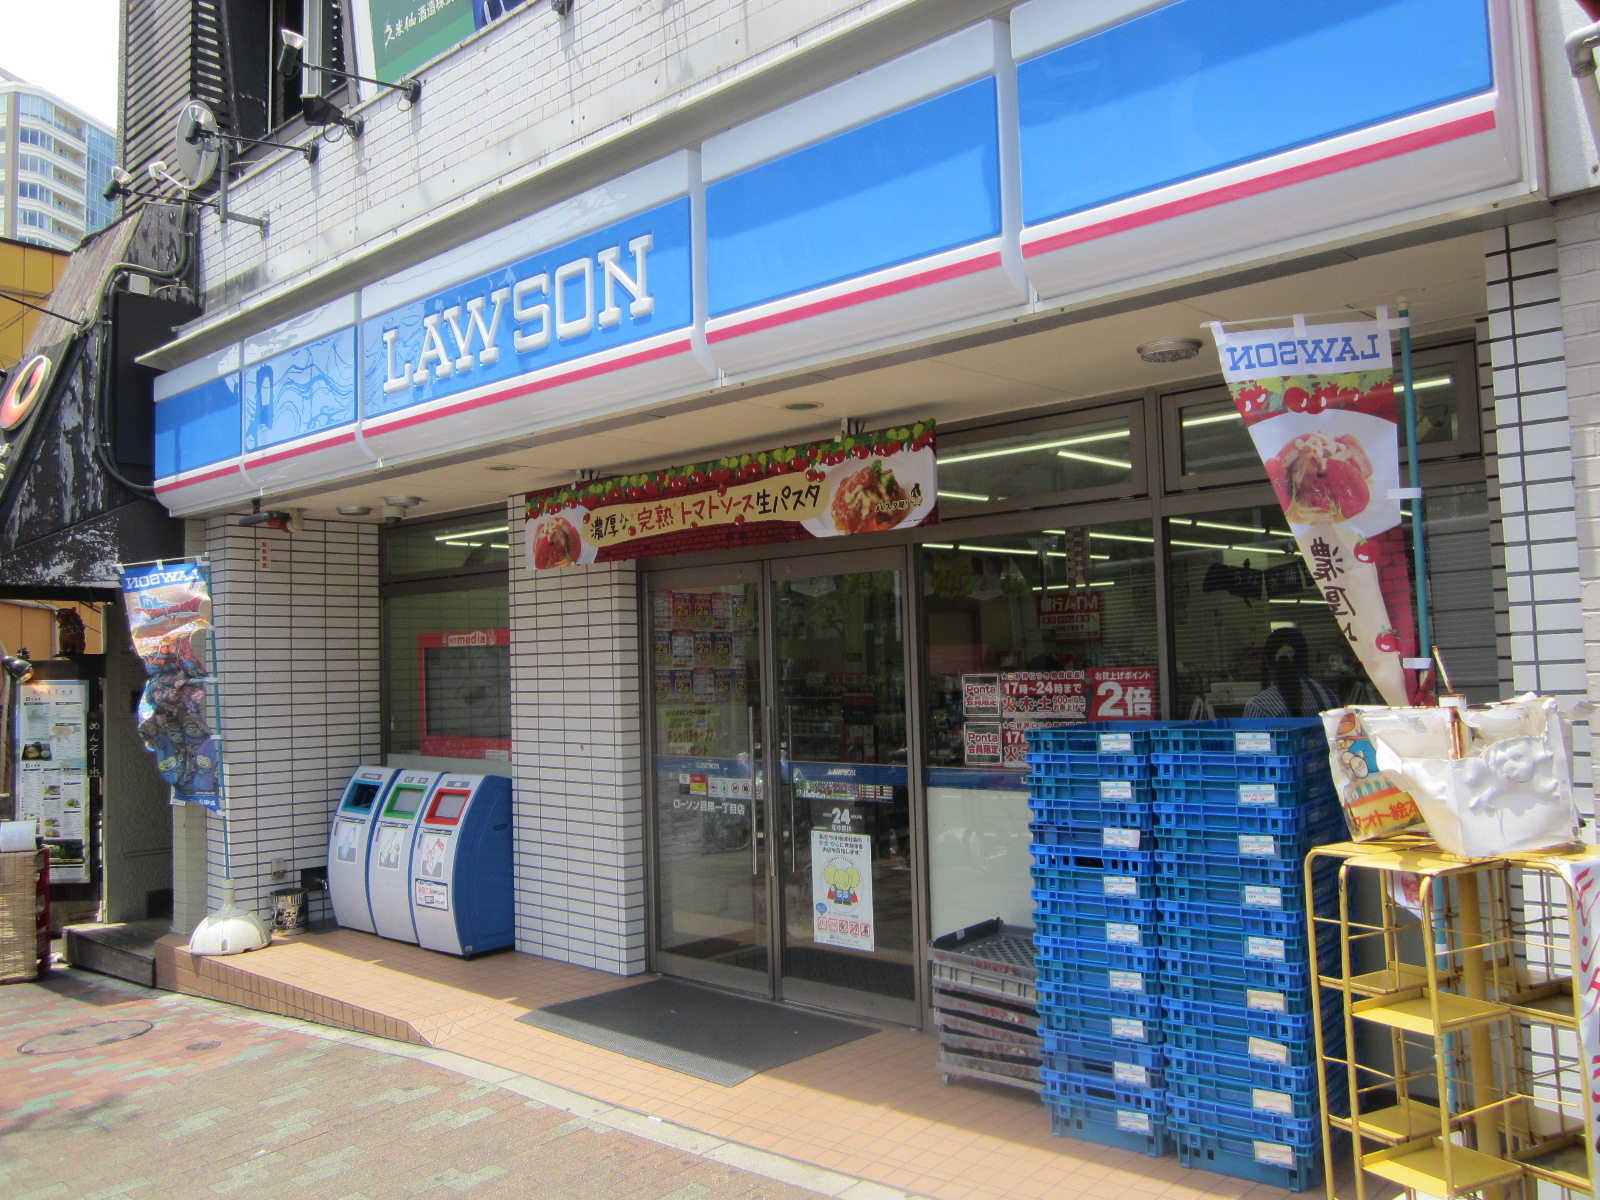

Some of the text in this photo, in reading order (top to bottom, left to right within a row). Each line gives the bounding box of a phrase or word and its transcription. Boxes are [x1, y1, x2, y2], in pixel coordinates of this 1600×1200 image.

[382, 234, 654, 394] LAWSON
[1095, 671, 1151, 680] お買上げポイント
[966, 684, 996, 695] Ponta
[966, 696, 997, 707] 会員限定
[1097, 681, 1151, 716] 2倍
[968, 733, 998, 743] Ponta
[968, 744, 998, 755] 会員限定
[827, 768, 856, 777] LAWSON
[673, 799, 745, 815] ローソン目黒一丁目店
[831, 807, 851, 825] 24
